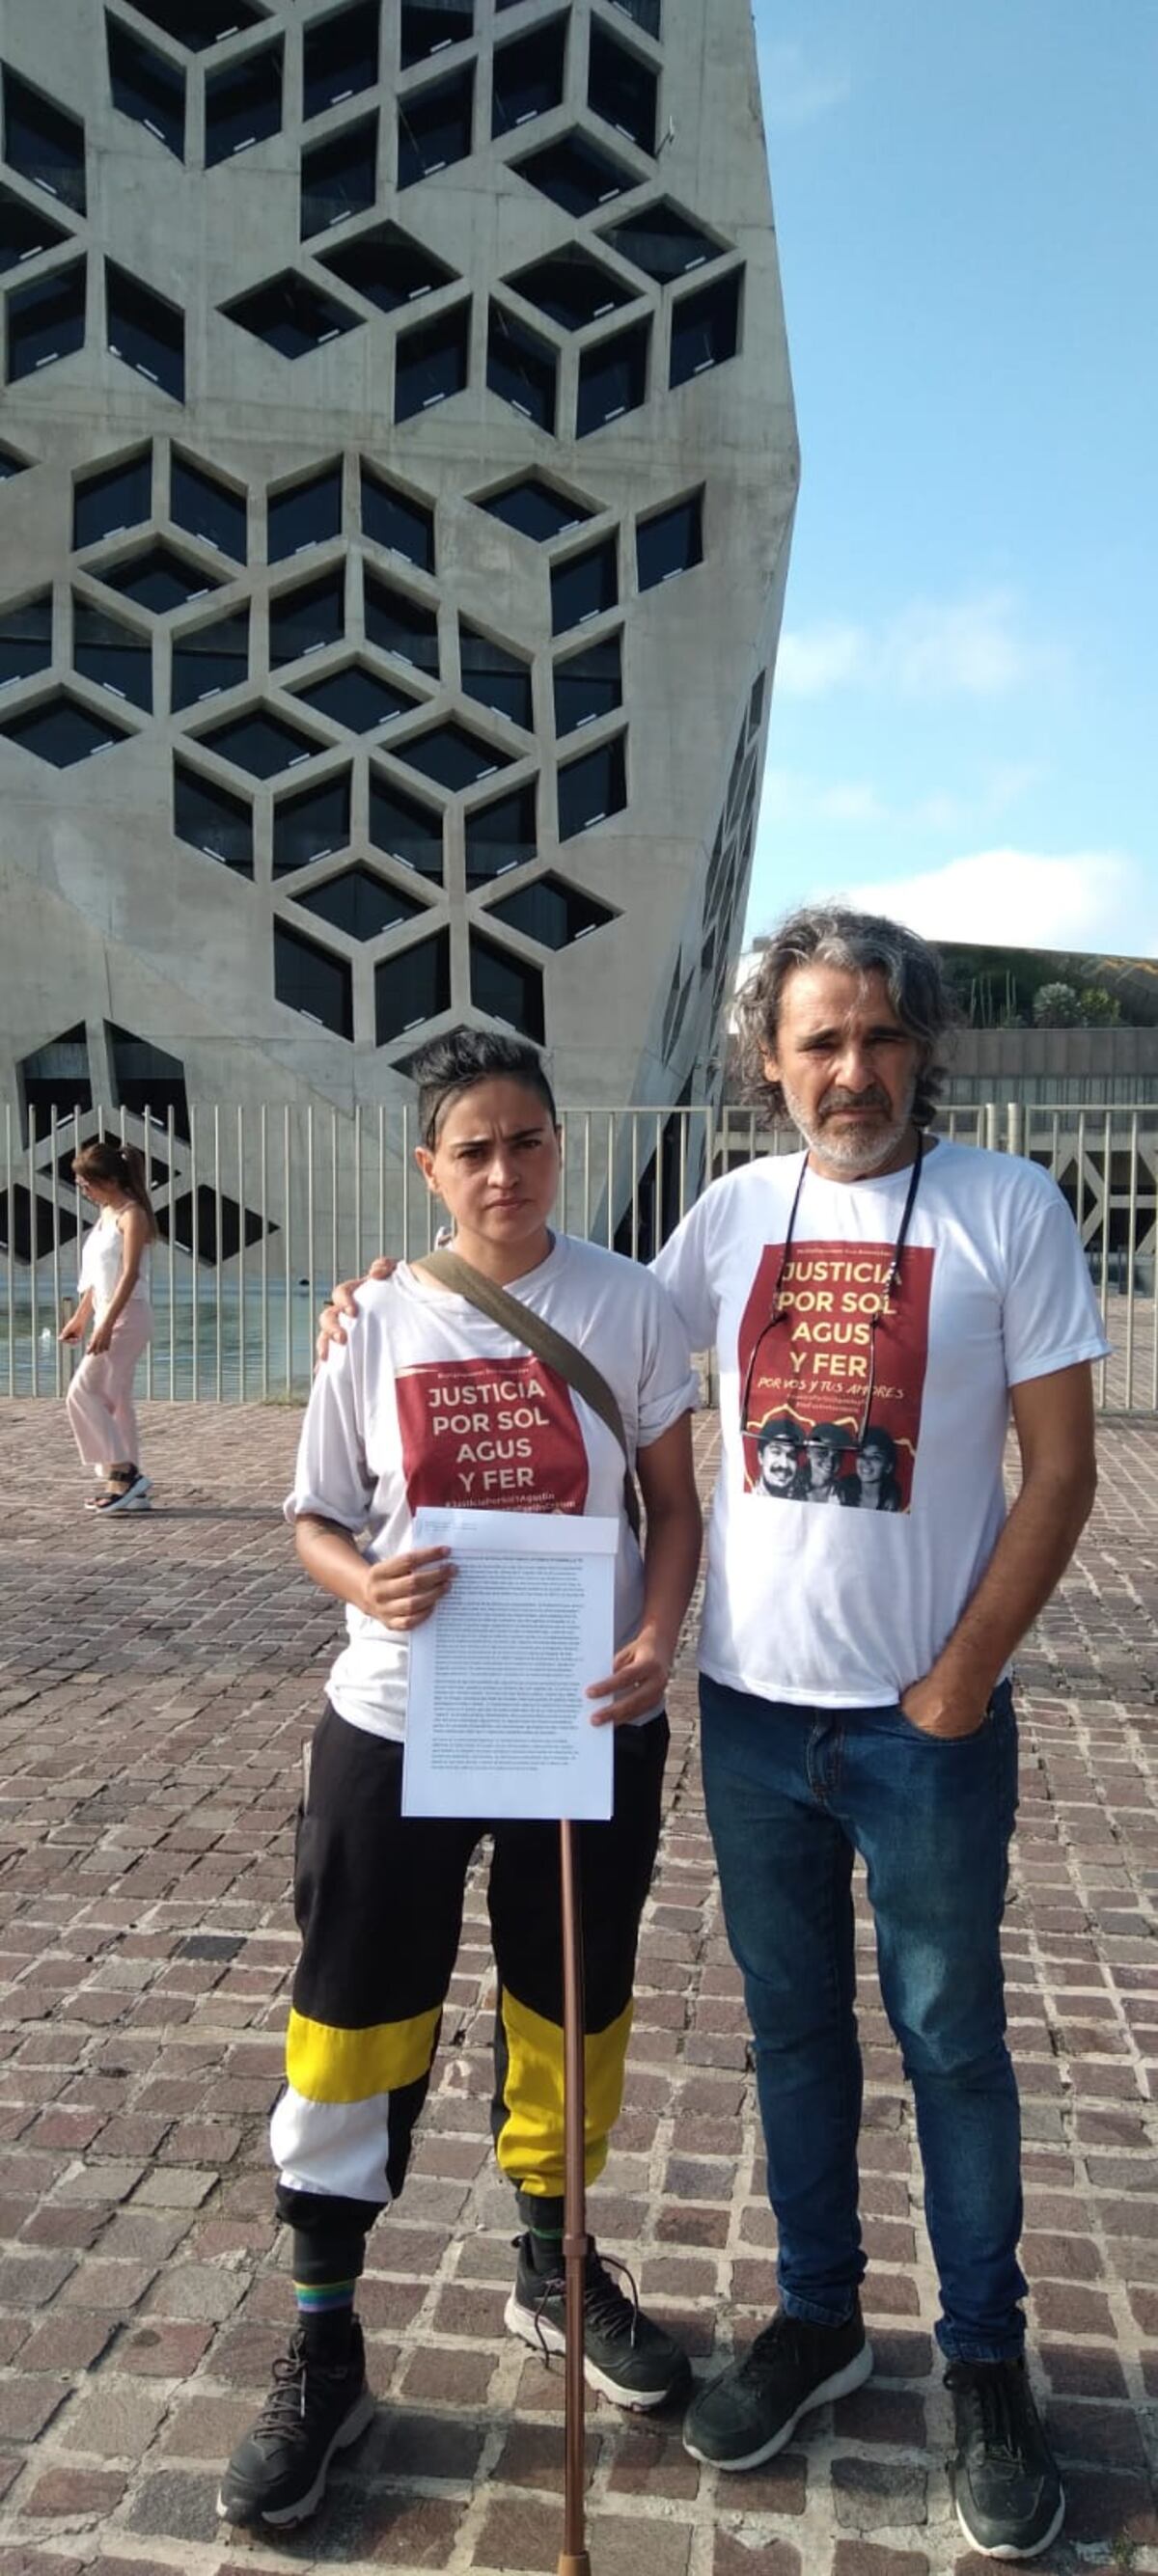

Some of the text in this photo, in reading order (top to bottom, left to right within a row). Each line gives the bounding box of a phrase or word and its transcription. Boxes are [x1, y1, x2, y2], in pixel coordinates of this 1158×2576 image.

[782, 1261, 902, 1285] JUSTICIA
[778, 1291, 896, 1315] POR SOL
[791, 1322, 869, 1345] AGUS
[789, 1351, 867, 1378] Y FER
[428, 1379, 545, 1408] JUSTICIA
[758, 1377, 782, 1389] POR
[784, 1379, 807, 1390] VOS
[809, 1380, 818, 1393] Y
[820, 1381, 842, 1393] TUS
[432, 1407, 549, 1436] POR SOL
[456, 1438, 532, 1464] AGUS
[458, 1467, 535, 1493] Y FER
